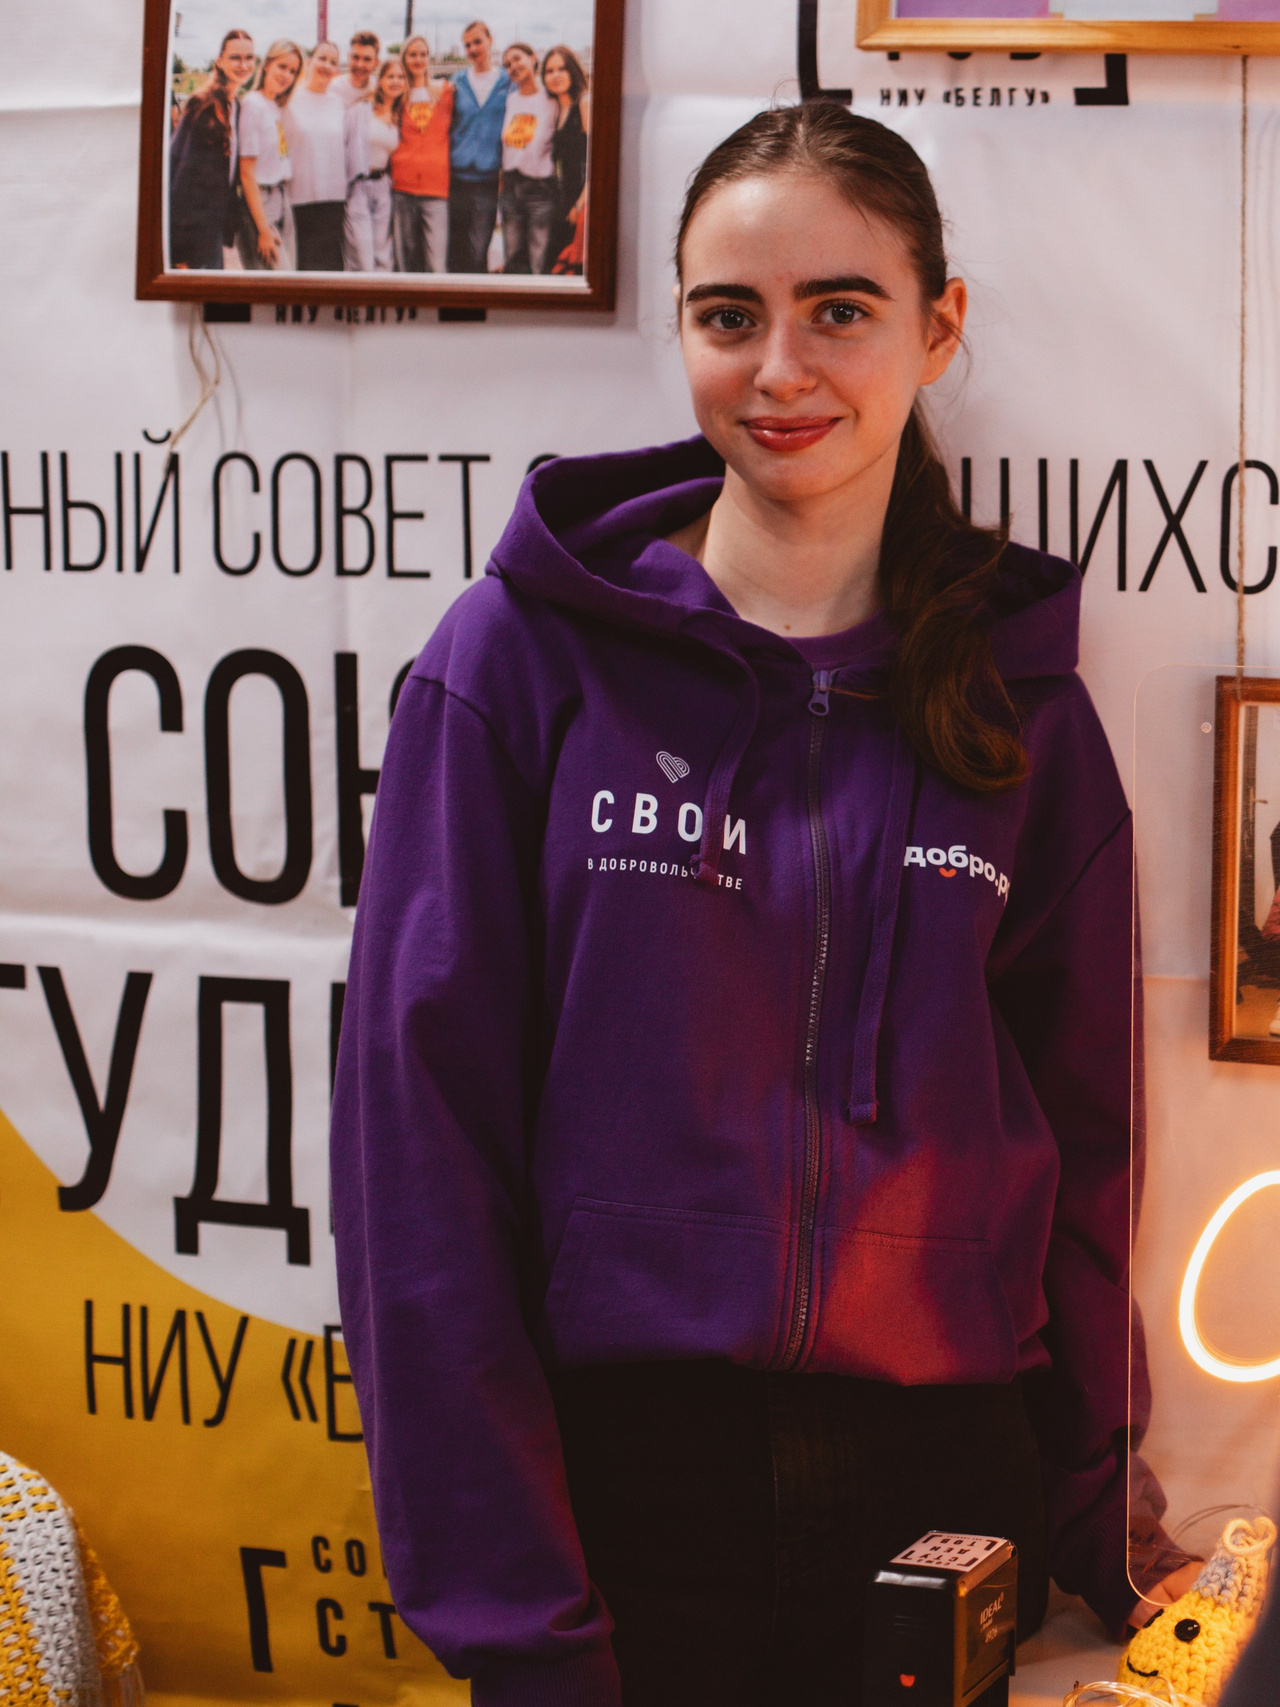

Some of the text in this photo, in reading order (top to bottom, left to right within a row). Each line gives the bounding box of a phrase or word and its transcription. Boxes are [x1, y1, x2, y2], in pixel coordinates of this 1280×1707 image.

[880, 87, 1049, 107] НИУ «БЕЛГУ»
[0, 429, 181, 574] НЫЙ
[212, 451, 491, 579] СОВЕТ
[591, 789, 746, 855] СВОИ
[587, 858, 743, 890] В ДОБРОВОЛЬТВЕ
[84, 1299, 249, 1428] НИУ
